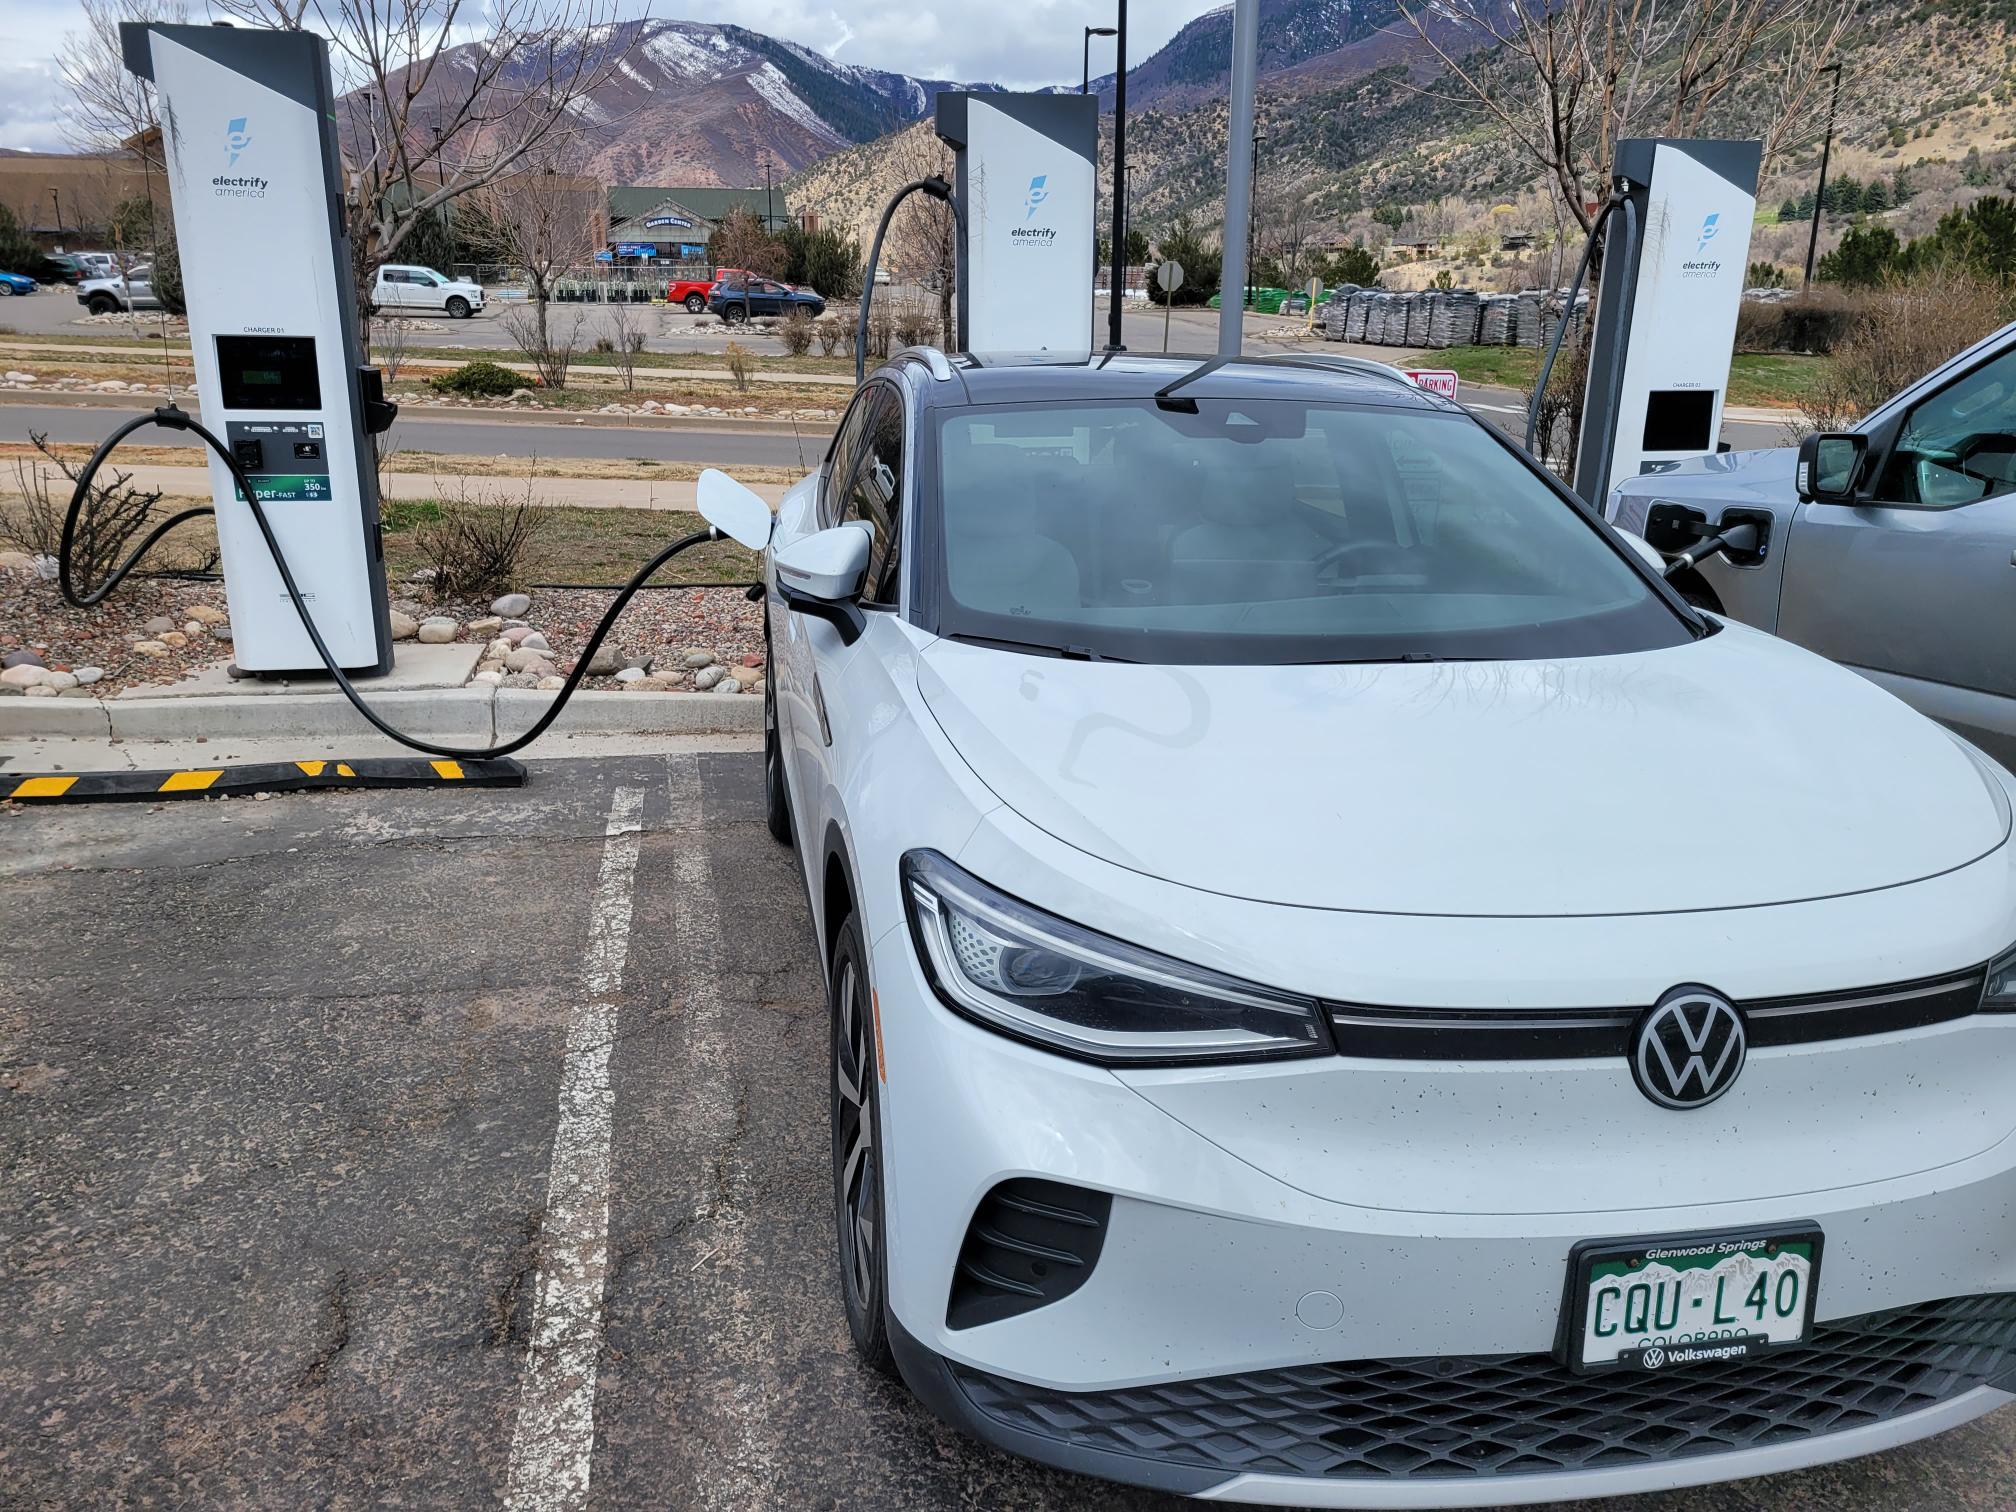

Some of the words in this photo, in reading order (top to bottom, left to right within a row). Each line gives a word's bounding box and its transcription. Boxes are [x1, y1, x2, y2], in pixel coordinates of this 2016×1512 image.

[212, 175, 268, 190] electrify
[215, 188, 265, 199] america
[1011, 228, 1057, 239] electrify
[1012, 238, 1053, 247] america
[1682, 260, 1721, 271] electrify
[1682, 270, 1717, 279] america
[243, 326, 276, 334] CHARGER
[1418, 377, 1453, 392] PARKING
[304, 483, 321, 491] 350
[238, 487, 297, 500] Hper-FAST
[1645, 1243, 1716, 1260] Glenwood
[1717, 1239, 1767, 1255] Springs
[1667, 1344, 1747, 1363] Volkswagen
